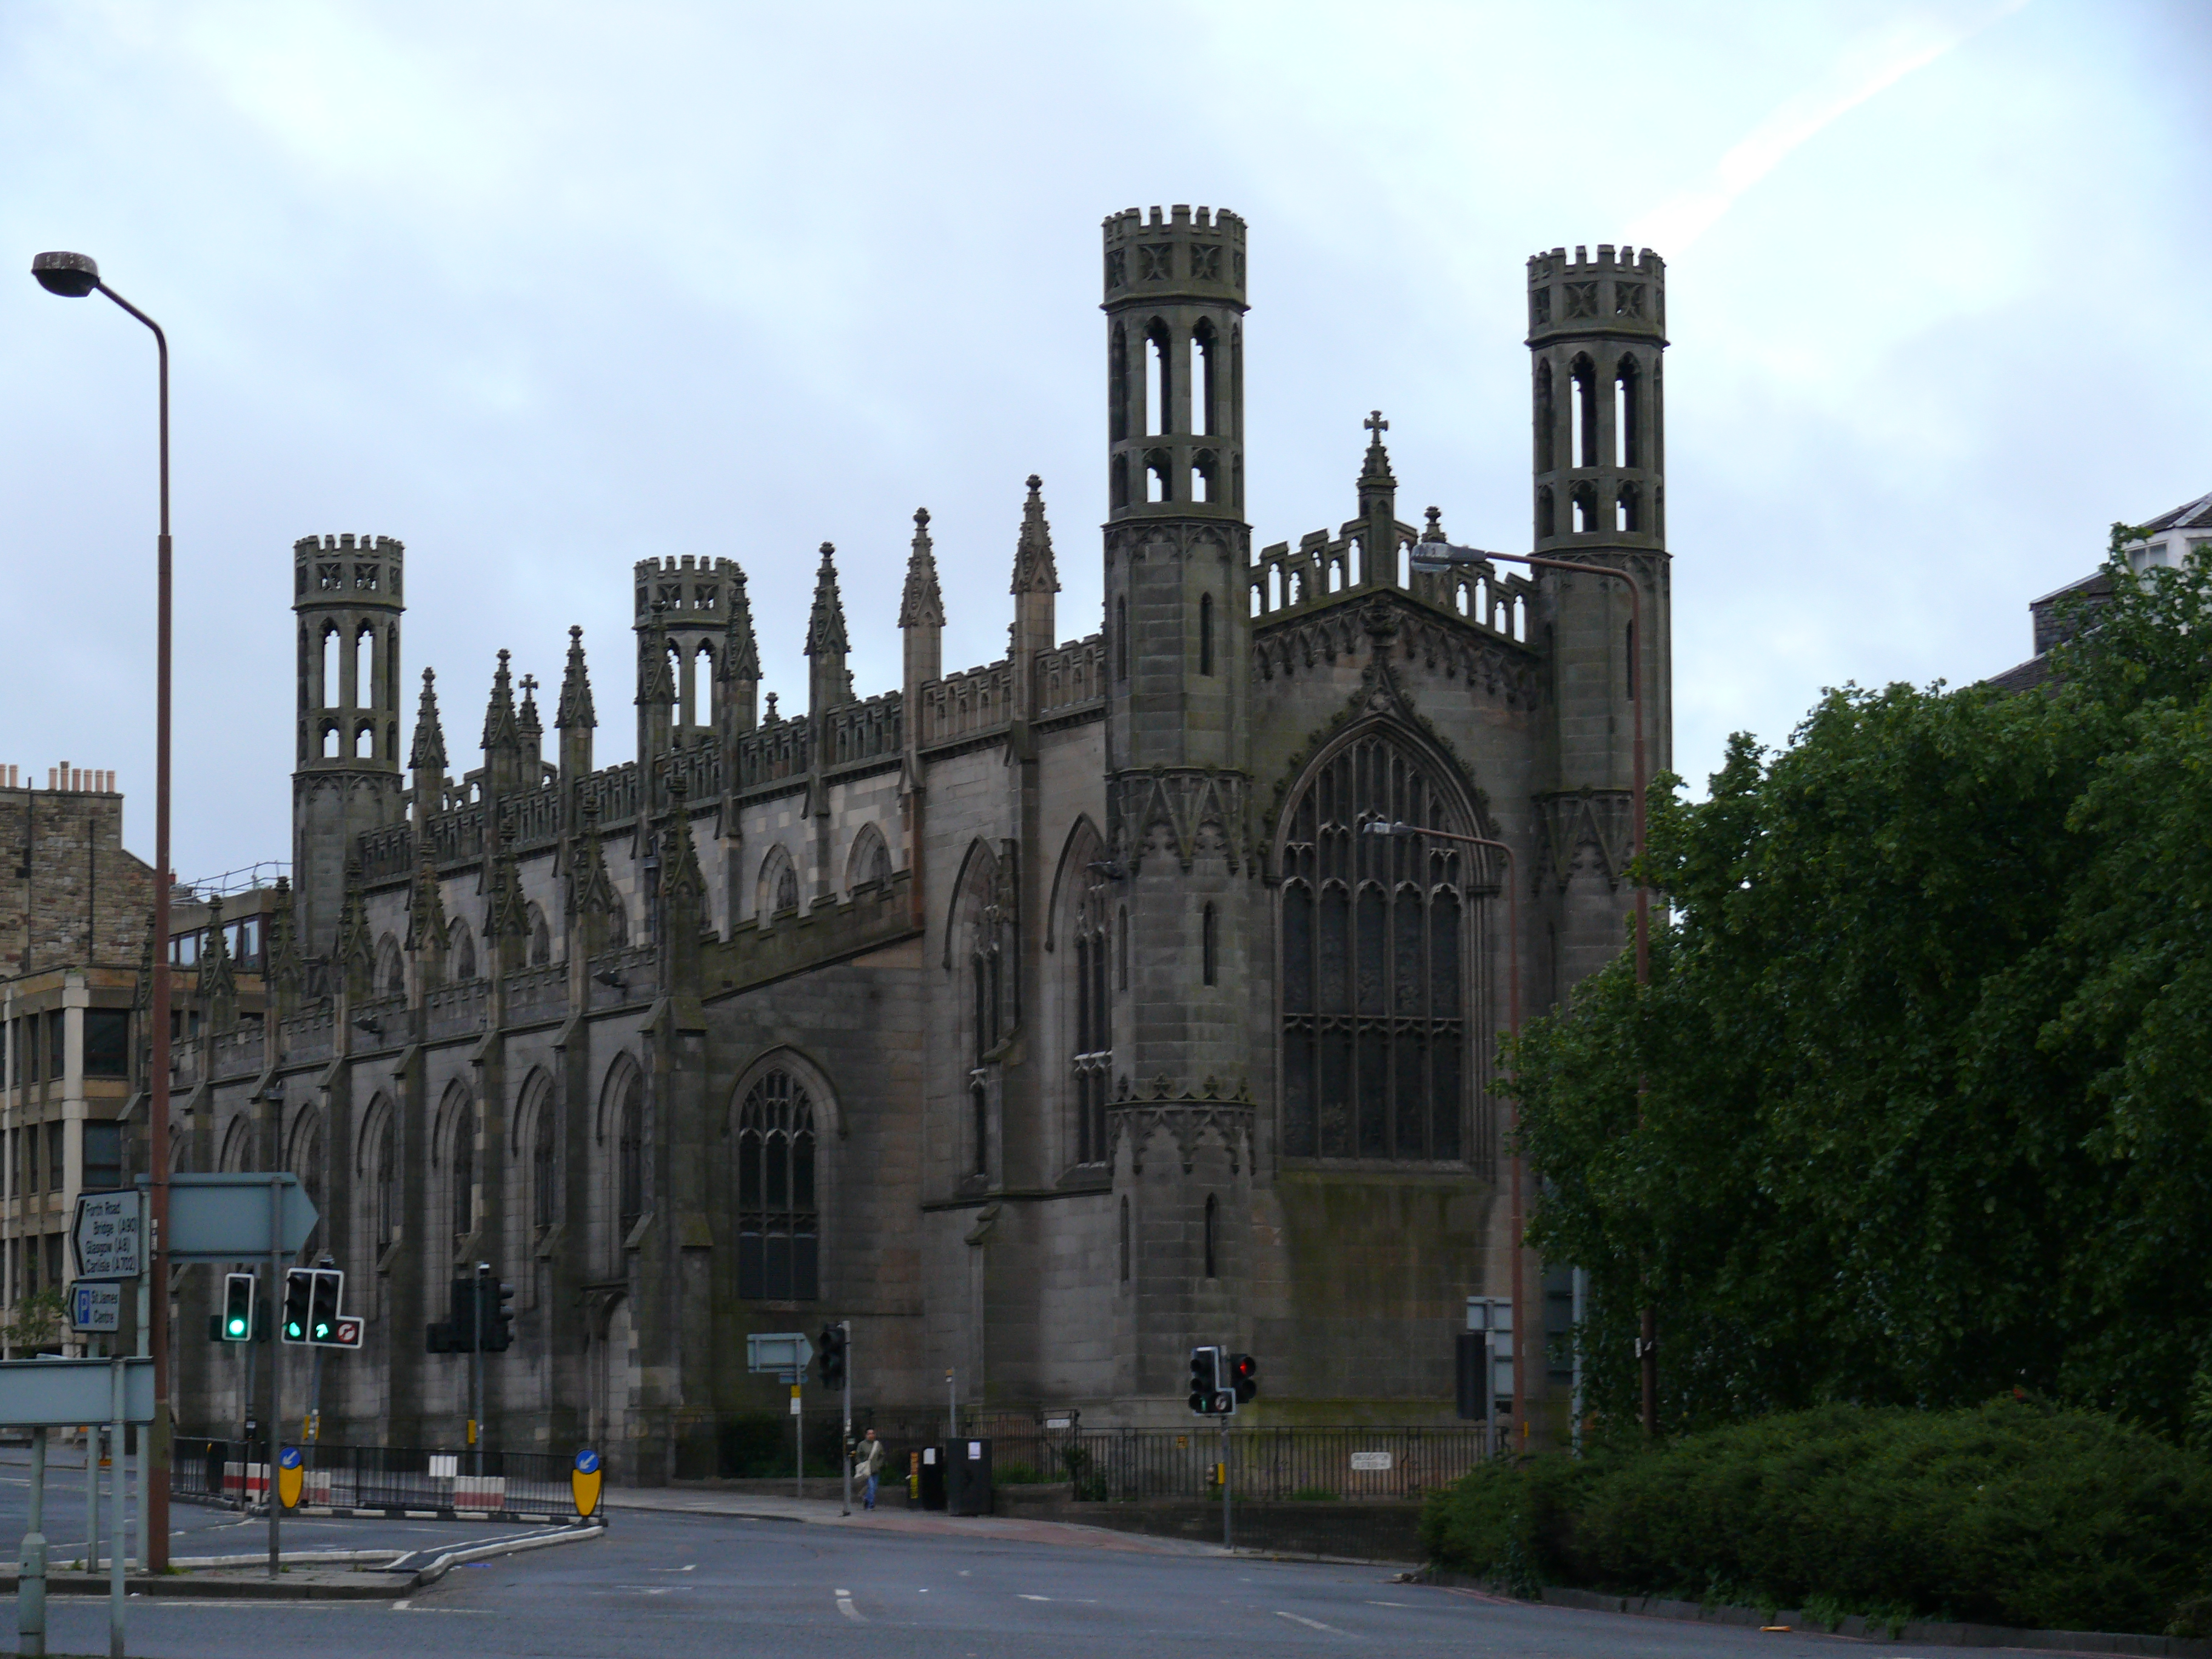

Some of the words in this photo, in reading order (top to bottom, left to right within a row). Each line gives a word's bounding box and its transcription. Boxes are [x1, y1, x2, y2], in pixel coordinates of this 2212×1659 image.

[85, 1202, 103, 1217] Forth
[105, 1201, 121, 1215] Road
[93, 1220, 114, 1237] Bridge
[85, 1240, 112, 1256] Glasgow
[85, 1258, 110, 1273] Carlisle
[81, 1293, 88, 1322] P
[93, 1309, 114, 1324] Centre
